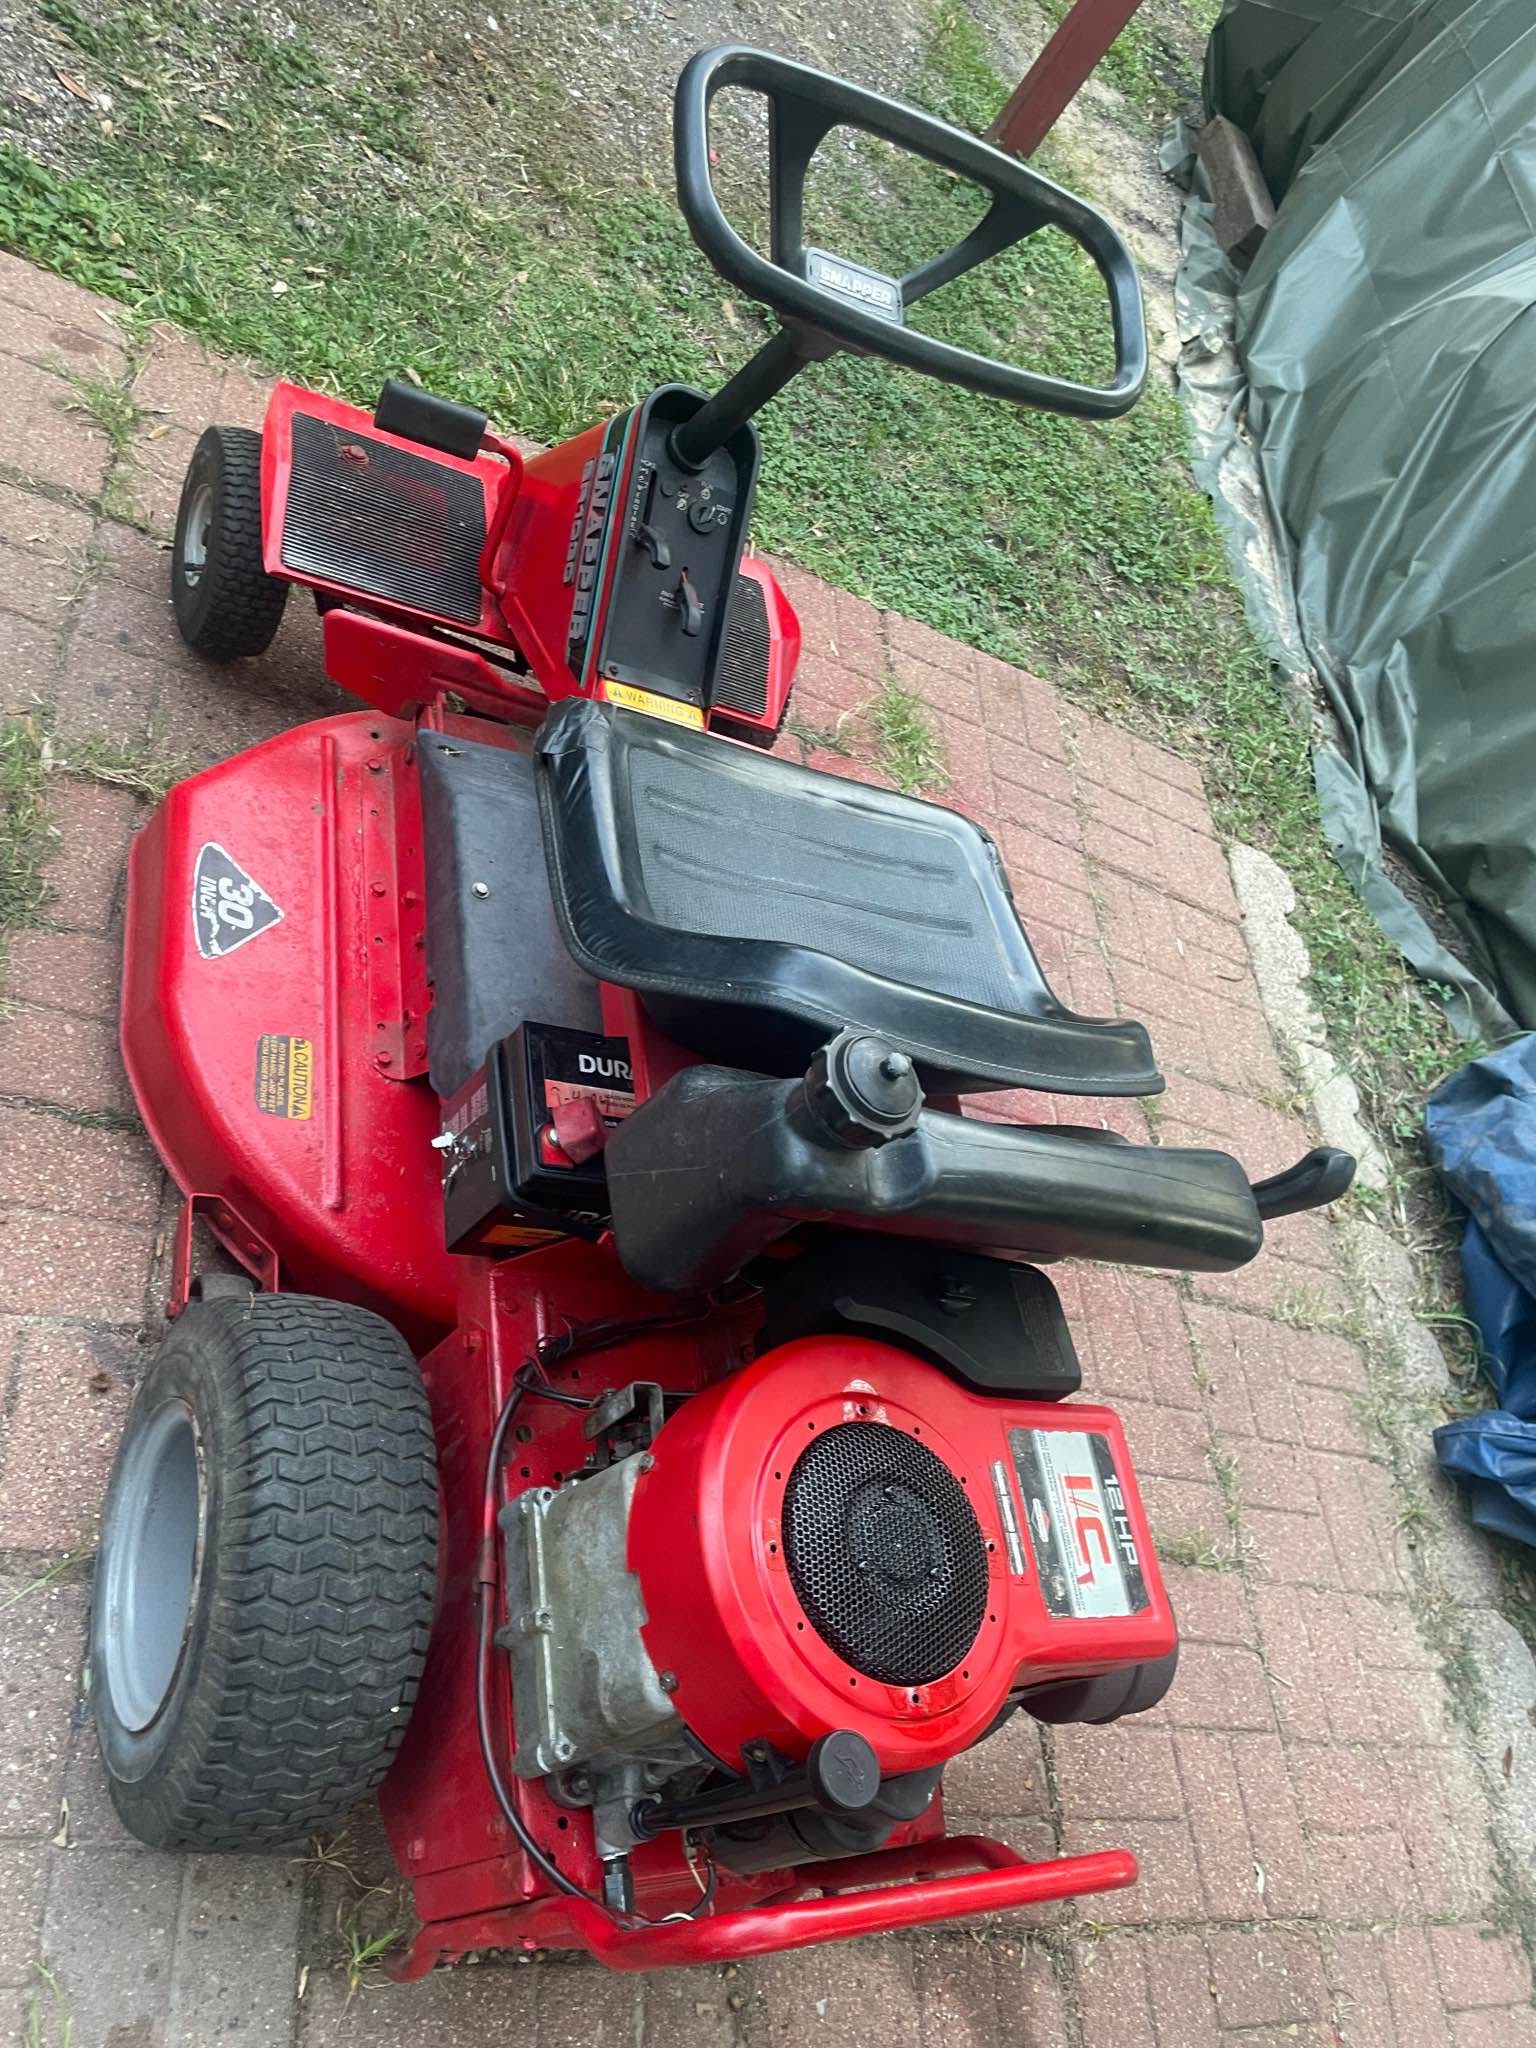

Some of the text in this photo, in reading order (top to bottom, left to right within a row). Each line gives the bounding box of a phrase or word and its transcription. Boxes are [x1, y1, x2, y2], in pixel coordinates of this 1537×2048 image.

[819, 263, 893, 305] SNAPPER
[569, 452, 616, 641] SNAPPER
[625, 690, 685, 717] WARNING
[198, 875, 217, 923] INCH
[217, 877, 254, 930] 30
[294, 1052, 307, 1104] CAUTION
[578, 1054, 633, 1080] DUR
[1103, 1474, 1125, 1509] 12
[1114, 1513, 1140, 1566] HP
